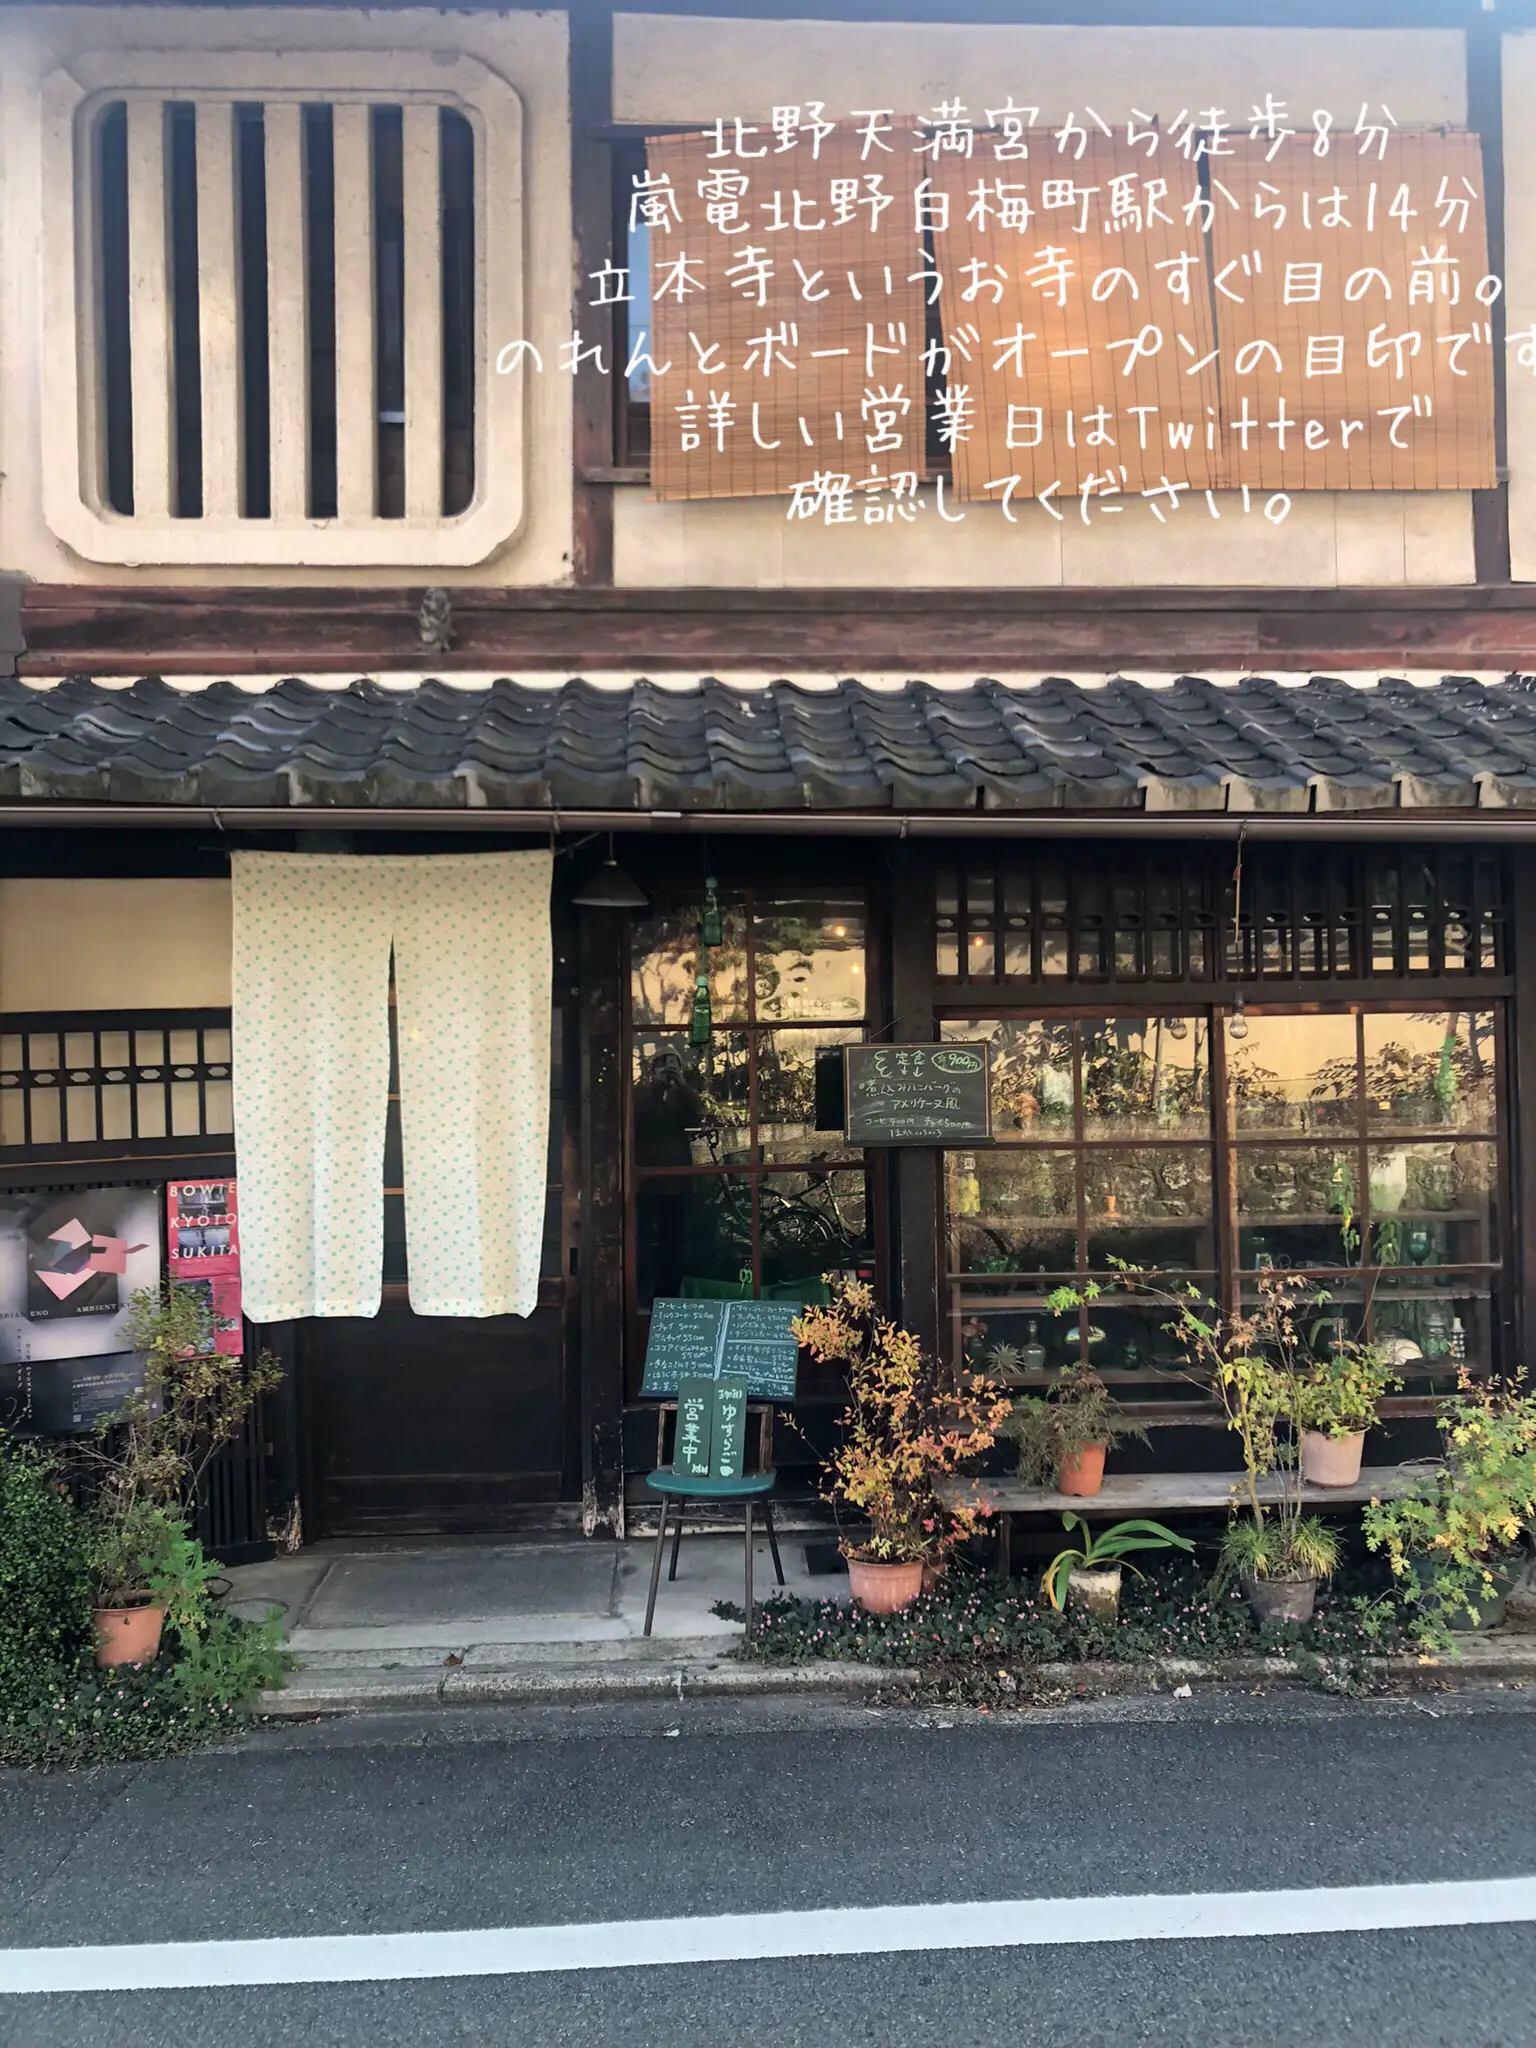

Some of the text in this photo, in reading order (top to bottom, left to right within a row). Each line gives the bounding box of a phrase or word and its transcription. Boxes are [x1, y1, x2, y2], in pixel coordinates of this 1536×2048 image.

[169, 1181, 237, 1198] BOWIE
[170, 1213, 238, 1229] KYOTO
[171, 1244, 239, 1260] SUKITA
[30, 1309, 49, 1317] ENO
[76, 1303, 117, 1313] AMBIENT
[681, 1397, 705, 1464] 営業中
[720, 1403, 738, 1464] ゆすらご
